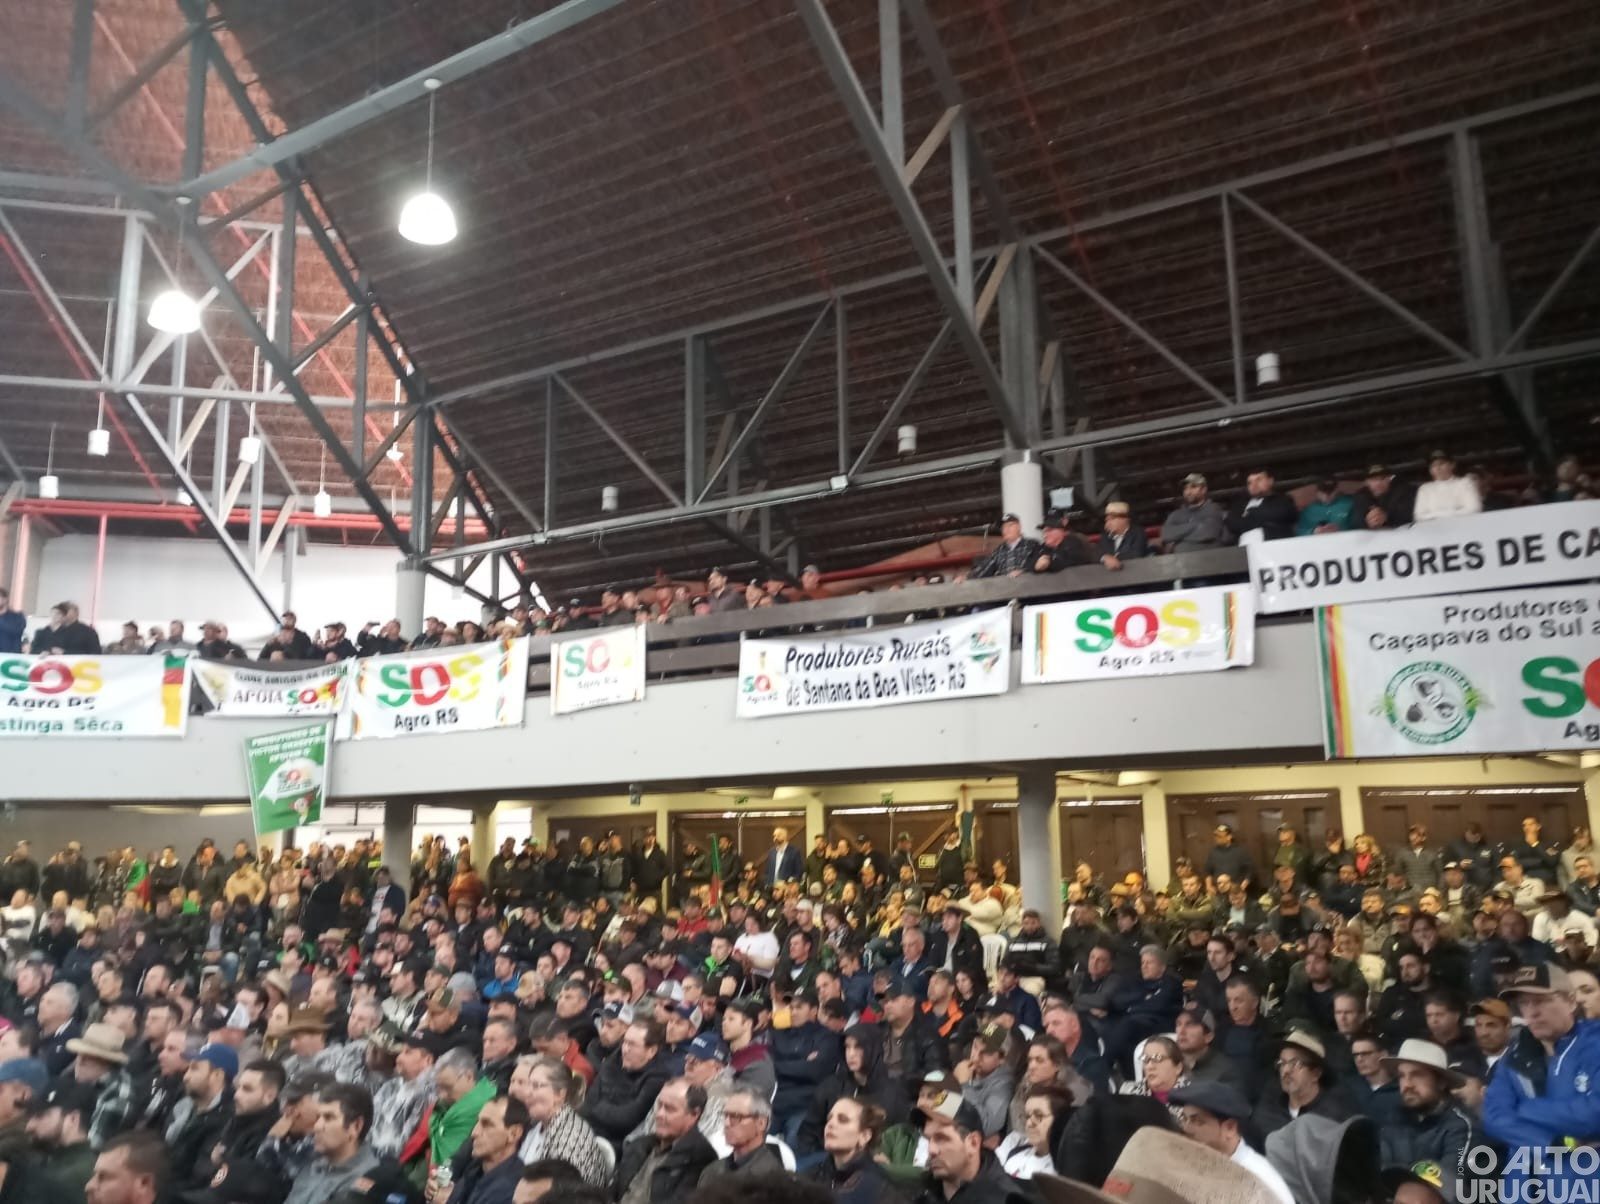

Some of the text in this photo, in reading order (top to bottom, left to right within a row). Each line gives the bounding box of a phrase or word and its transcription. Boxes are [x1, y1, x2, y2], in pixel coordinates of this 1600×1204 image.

[1259, 540, 1486, 592] PRODUTORES
[1497, 534, 1546, 566] DE
[1074, 600, 1201, 653] SOS
[1443, 598, 1588, 624] Produtores
[785, 642, 885, 673] Produtores
[890, 629, 951, 661] Rurais
[1369, 629, 1489, 653] Caçapava
[1498, 622, 1531, 642] do
[1540, 617, 1583, 639] Sul
[0, 659, 104, 694] SOS
[376, 655, 485, 707] SOS
[786, 679, 800, 706] de
[804, 679, 852, 705] Santana
[855, 674, 870, 700] da
[873, 672, 899, 698] Boa
[901, 667, 936, 696] Vista
[395, 714, 430, 731] Agro
